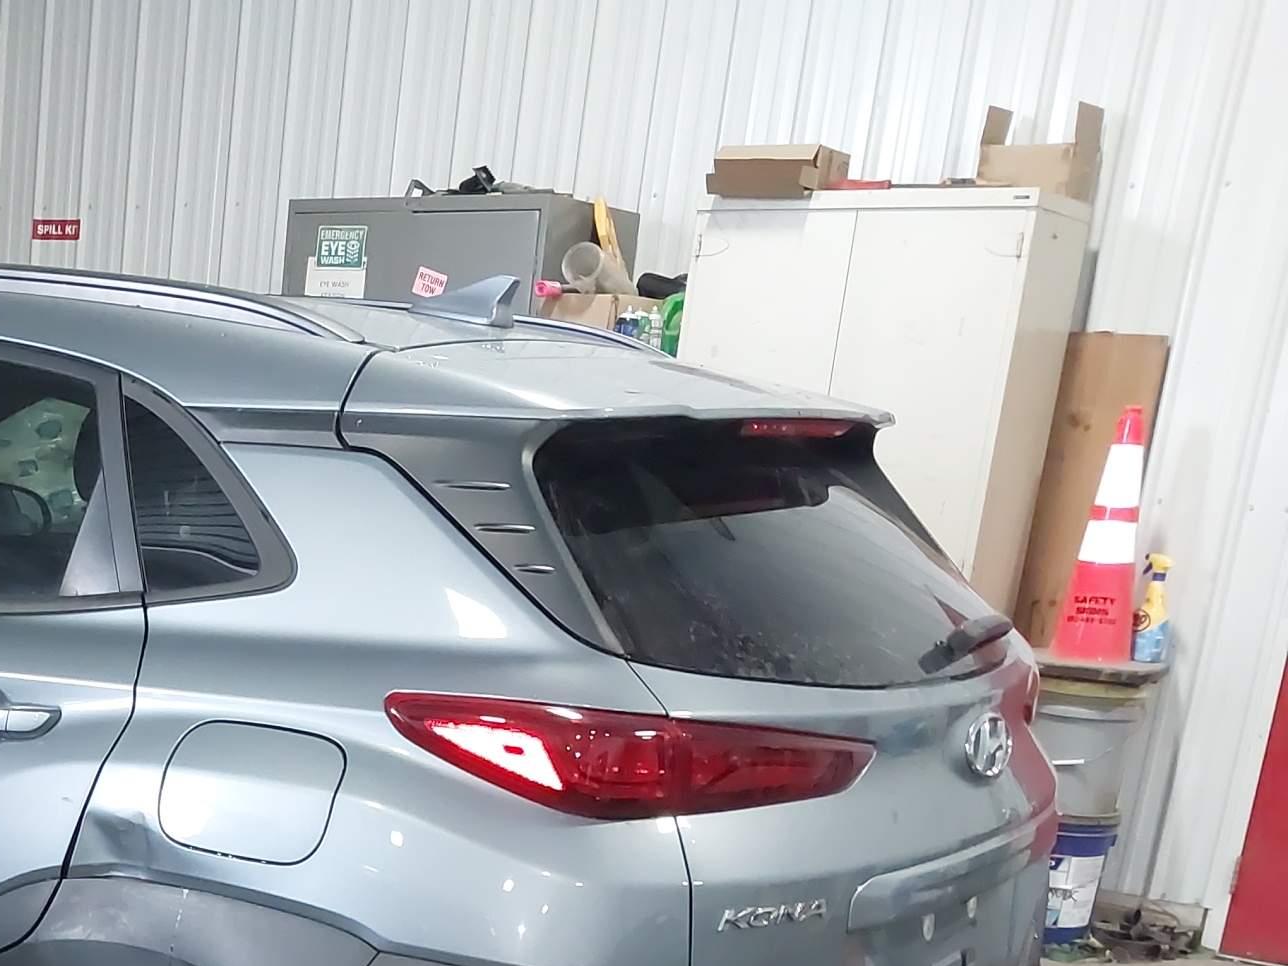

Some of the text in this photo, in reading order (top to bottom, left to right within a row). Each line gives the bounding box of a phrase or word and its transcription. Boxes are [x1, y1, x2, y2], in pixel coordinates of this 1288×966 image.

[37, 224, 63, 235] SPILL
[320, 229, 364, 241] EMERGENCY
[321, 240, 346, 256] EYE
[320, 256, 345, 264] WASH
[418, 271, 445, 288] RETURN
[421, 283, 436, 295] TOW
[717, 899, 826, 932] KONA
